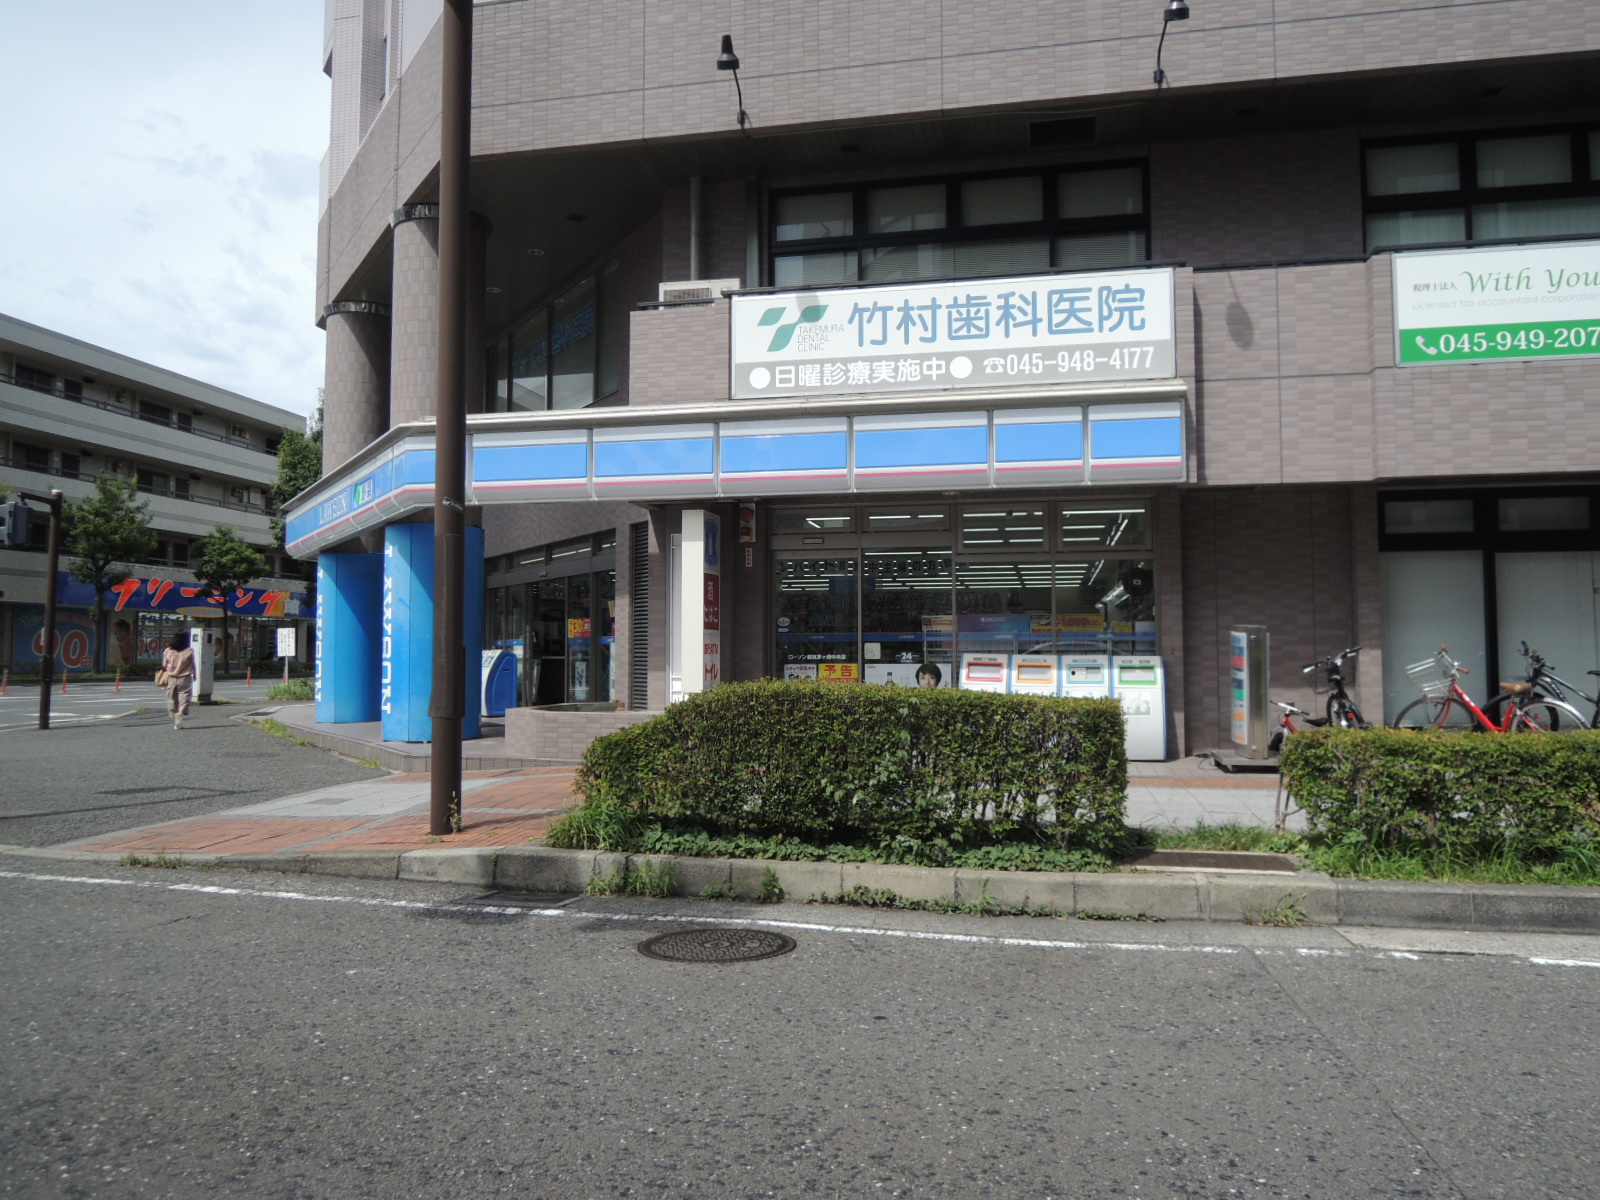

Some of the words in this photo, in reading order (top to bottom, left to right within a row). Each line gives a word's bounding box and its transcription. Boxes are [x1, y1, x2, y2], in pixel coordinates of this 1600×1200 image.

[1413, 282, 1458, 292] 税理士法人
[1460, 267, 1534, 293] With
[1413, 299, 1457, 311] Licensed
[1460, 298, 1475, 308] tax
[1477, 293, 1539, 307] accountant
[847, 283, 1146, 348] 竹村歯科医院
[798, 324, 845, 335] TAKEMURA
[797, 333, 831, 344] DENTAL
[797, 342, 825, 352] CLINIC
[1005, 346, 1154, 375] 045-948-4177
[775, 356, 946, 388] 日曜診療実施中
[824, 664, 853, 677] 予告
